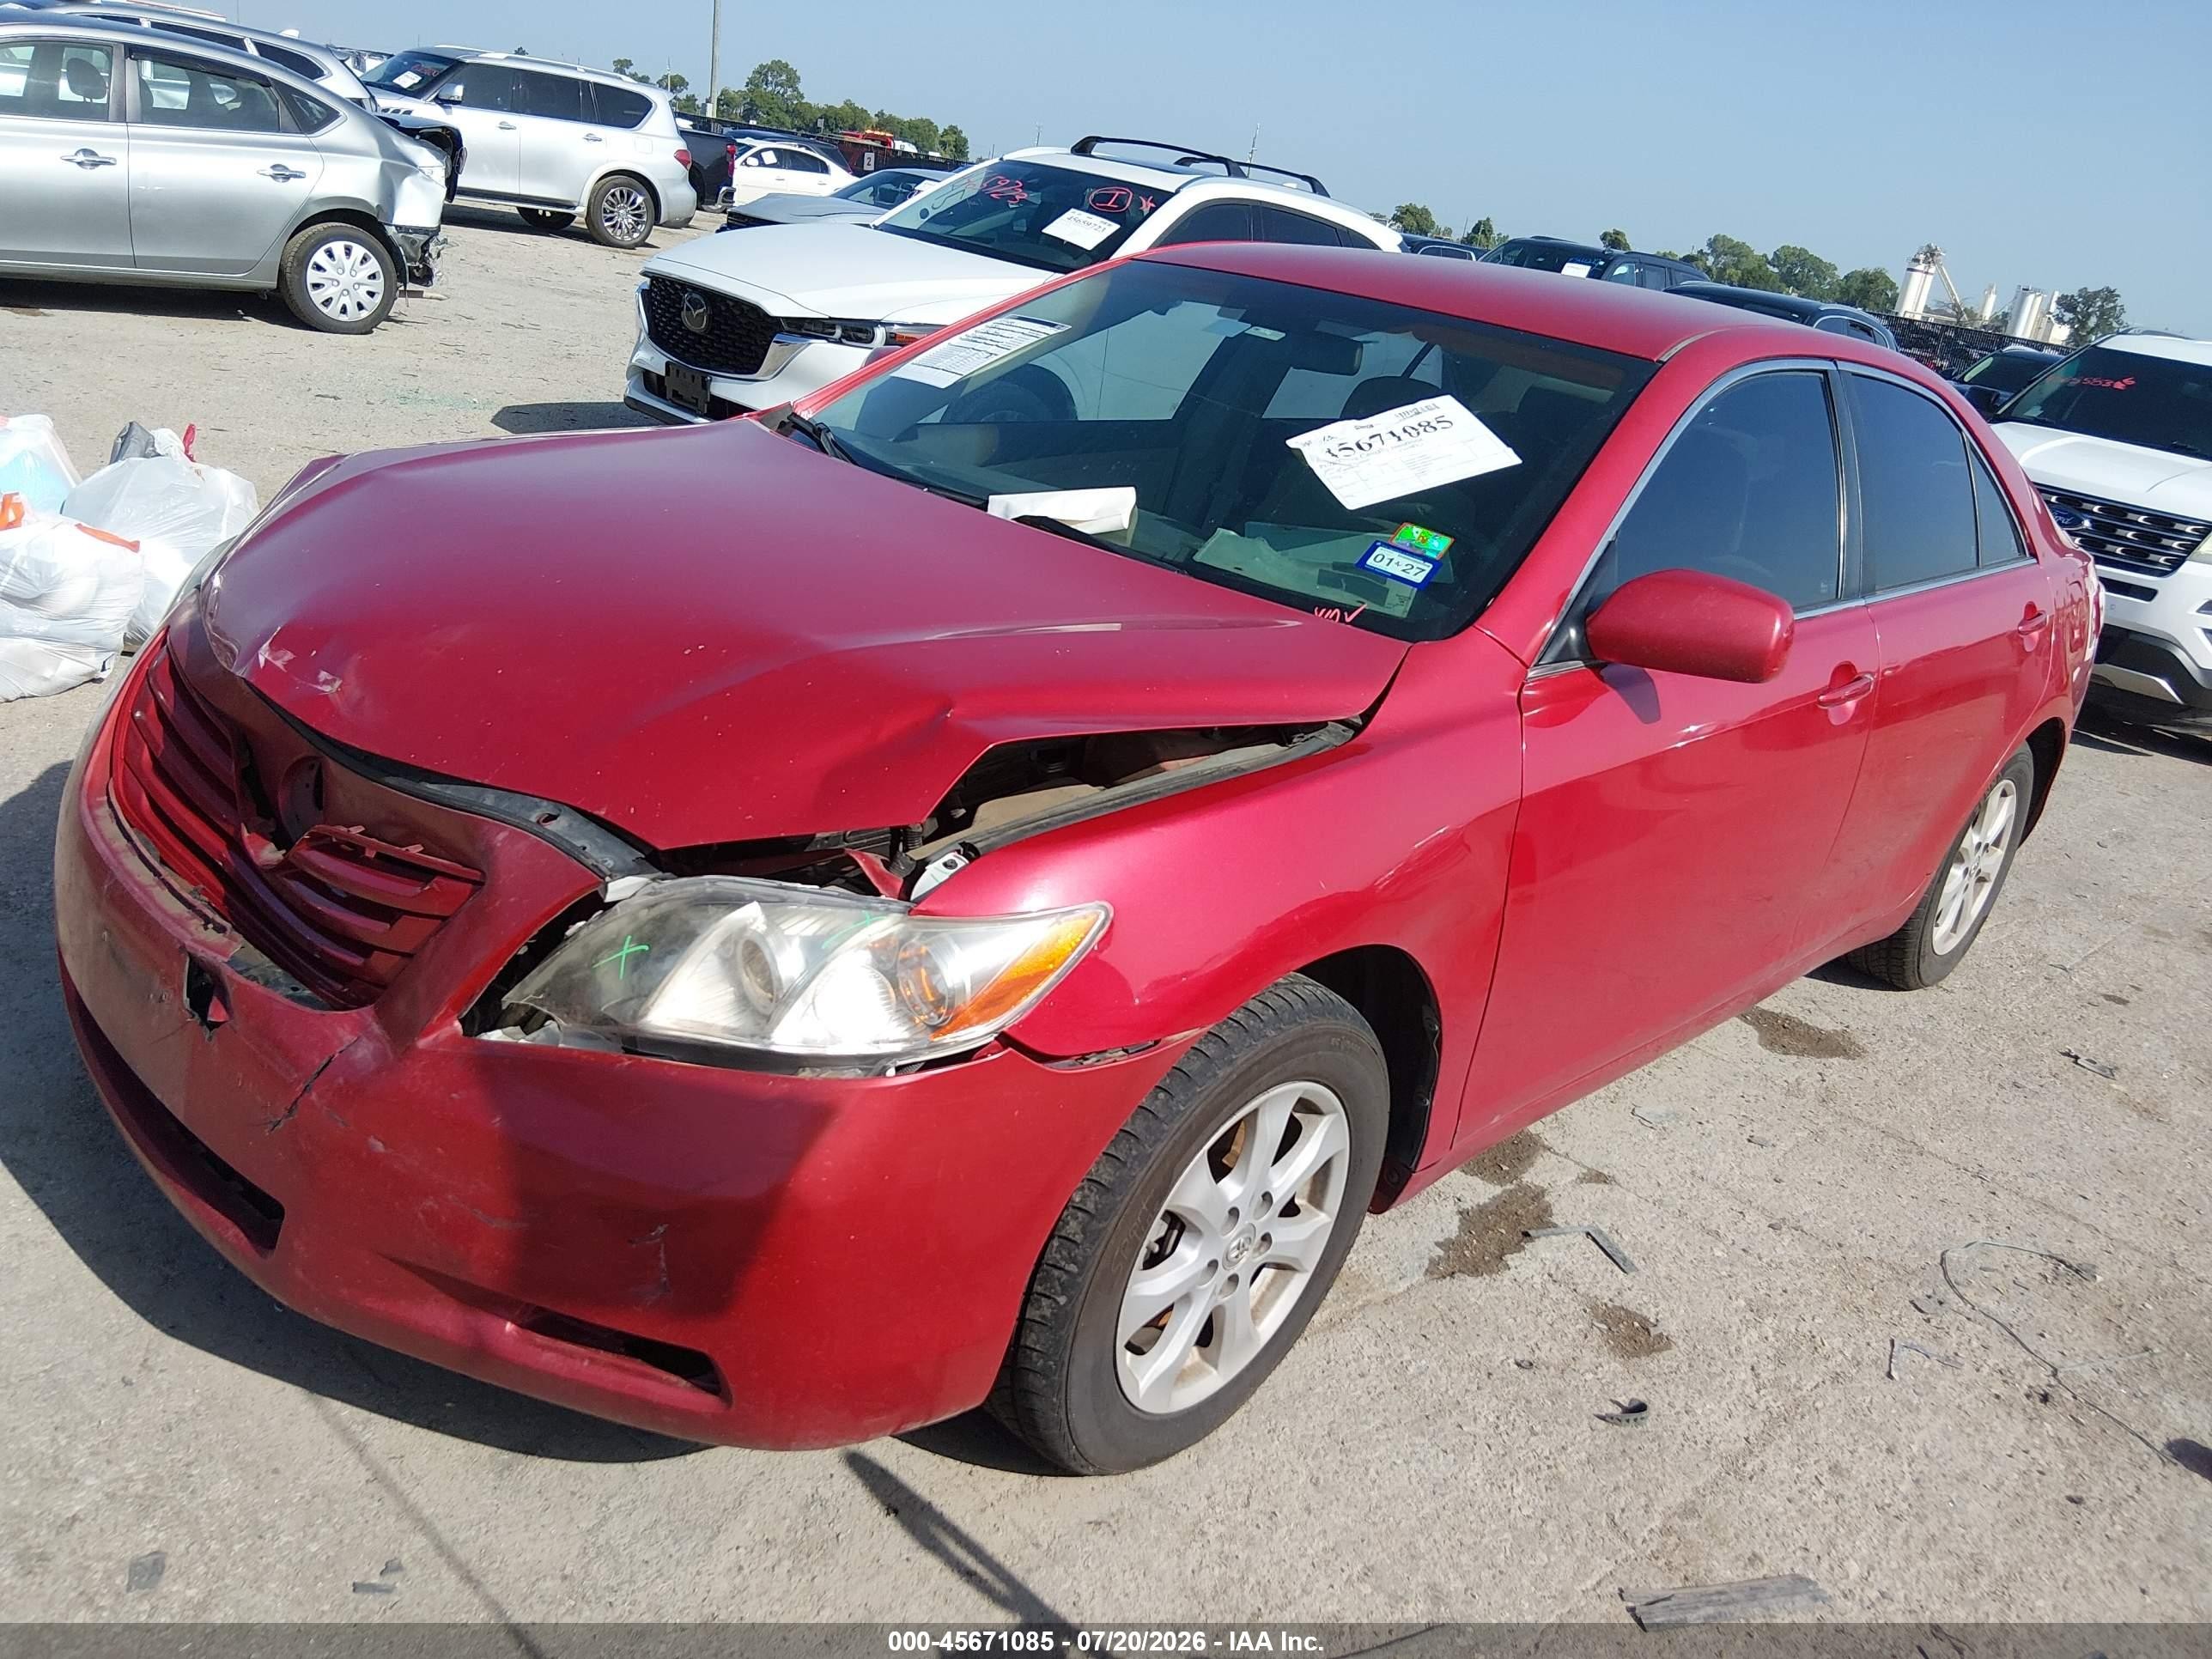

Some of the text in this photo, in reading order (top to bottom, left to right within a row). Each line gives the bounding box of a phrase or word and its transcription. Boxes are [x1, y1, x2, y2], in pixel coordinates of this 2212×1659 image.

[866, 156, 872, 167] 2
[1372, 553, 1395, 568] 01
[1401, 563, 1426, 577] 27
